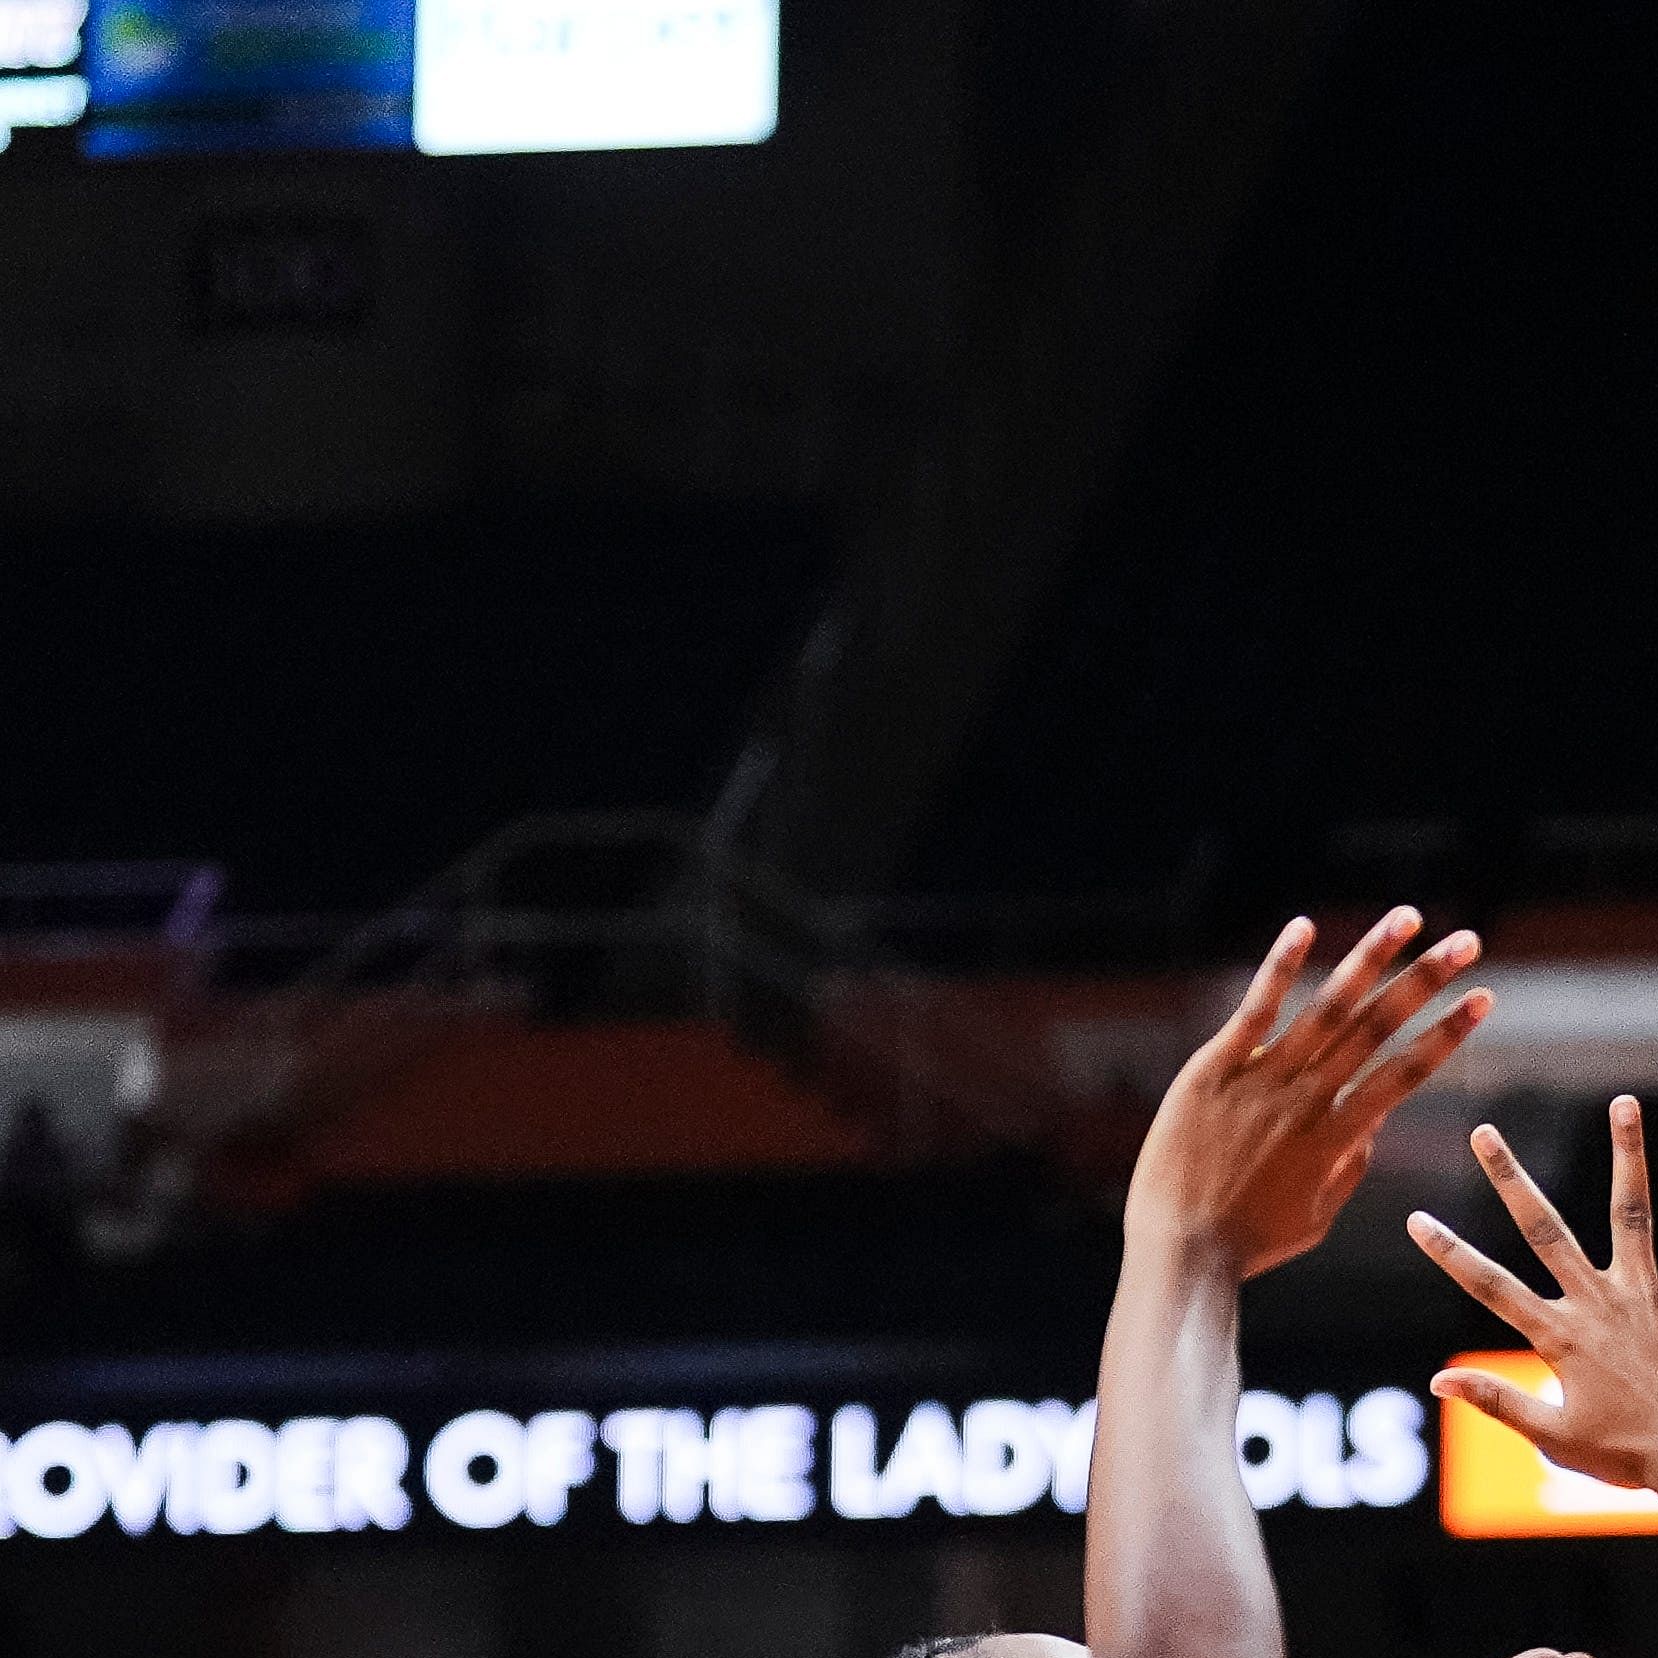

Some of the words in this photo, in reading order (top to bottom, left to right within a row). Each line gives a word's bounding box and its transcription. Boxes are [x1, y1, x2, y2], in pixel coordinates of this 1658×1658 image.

[0, 1416, 413, 1540] OVIDER
[424, 1408, 597, 1528] OF
[600, 1402, 818, 1525] THE
[1236, 1386, 1430, 1509] OLS
